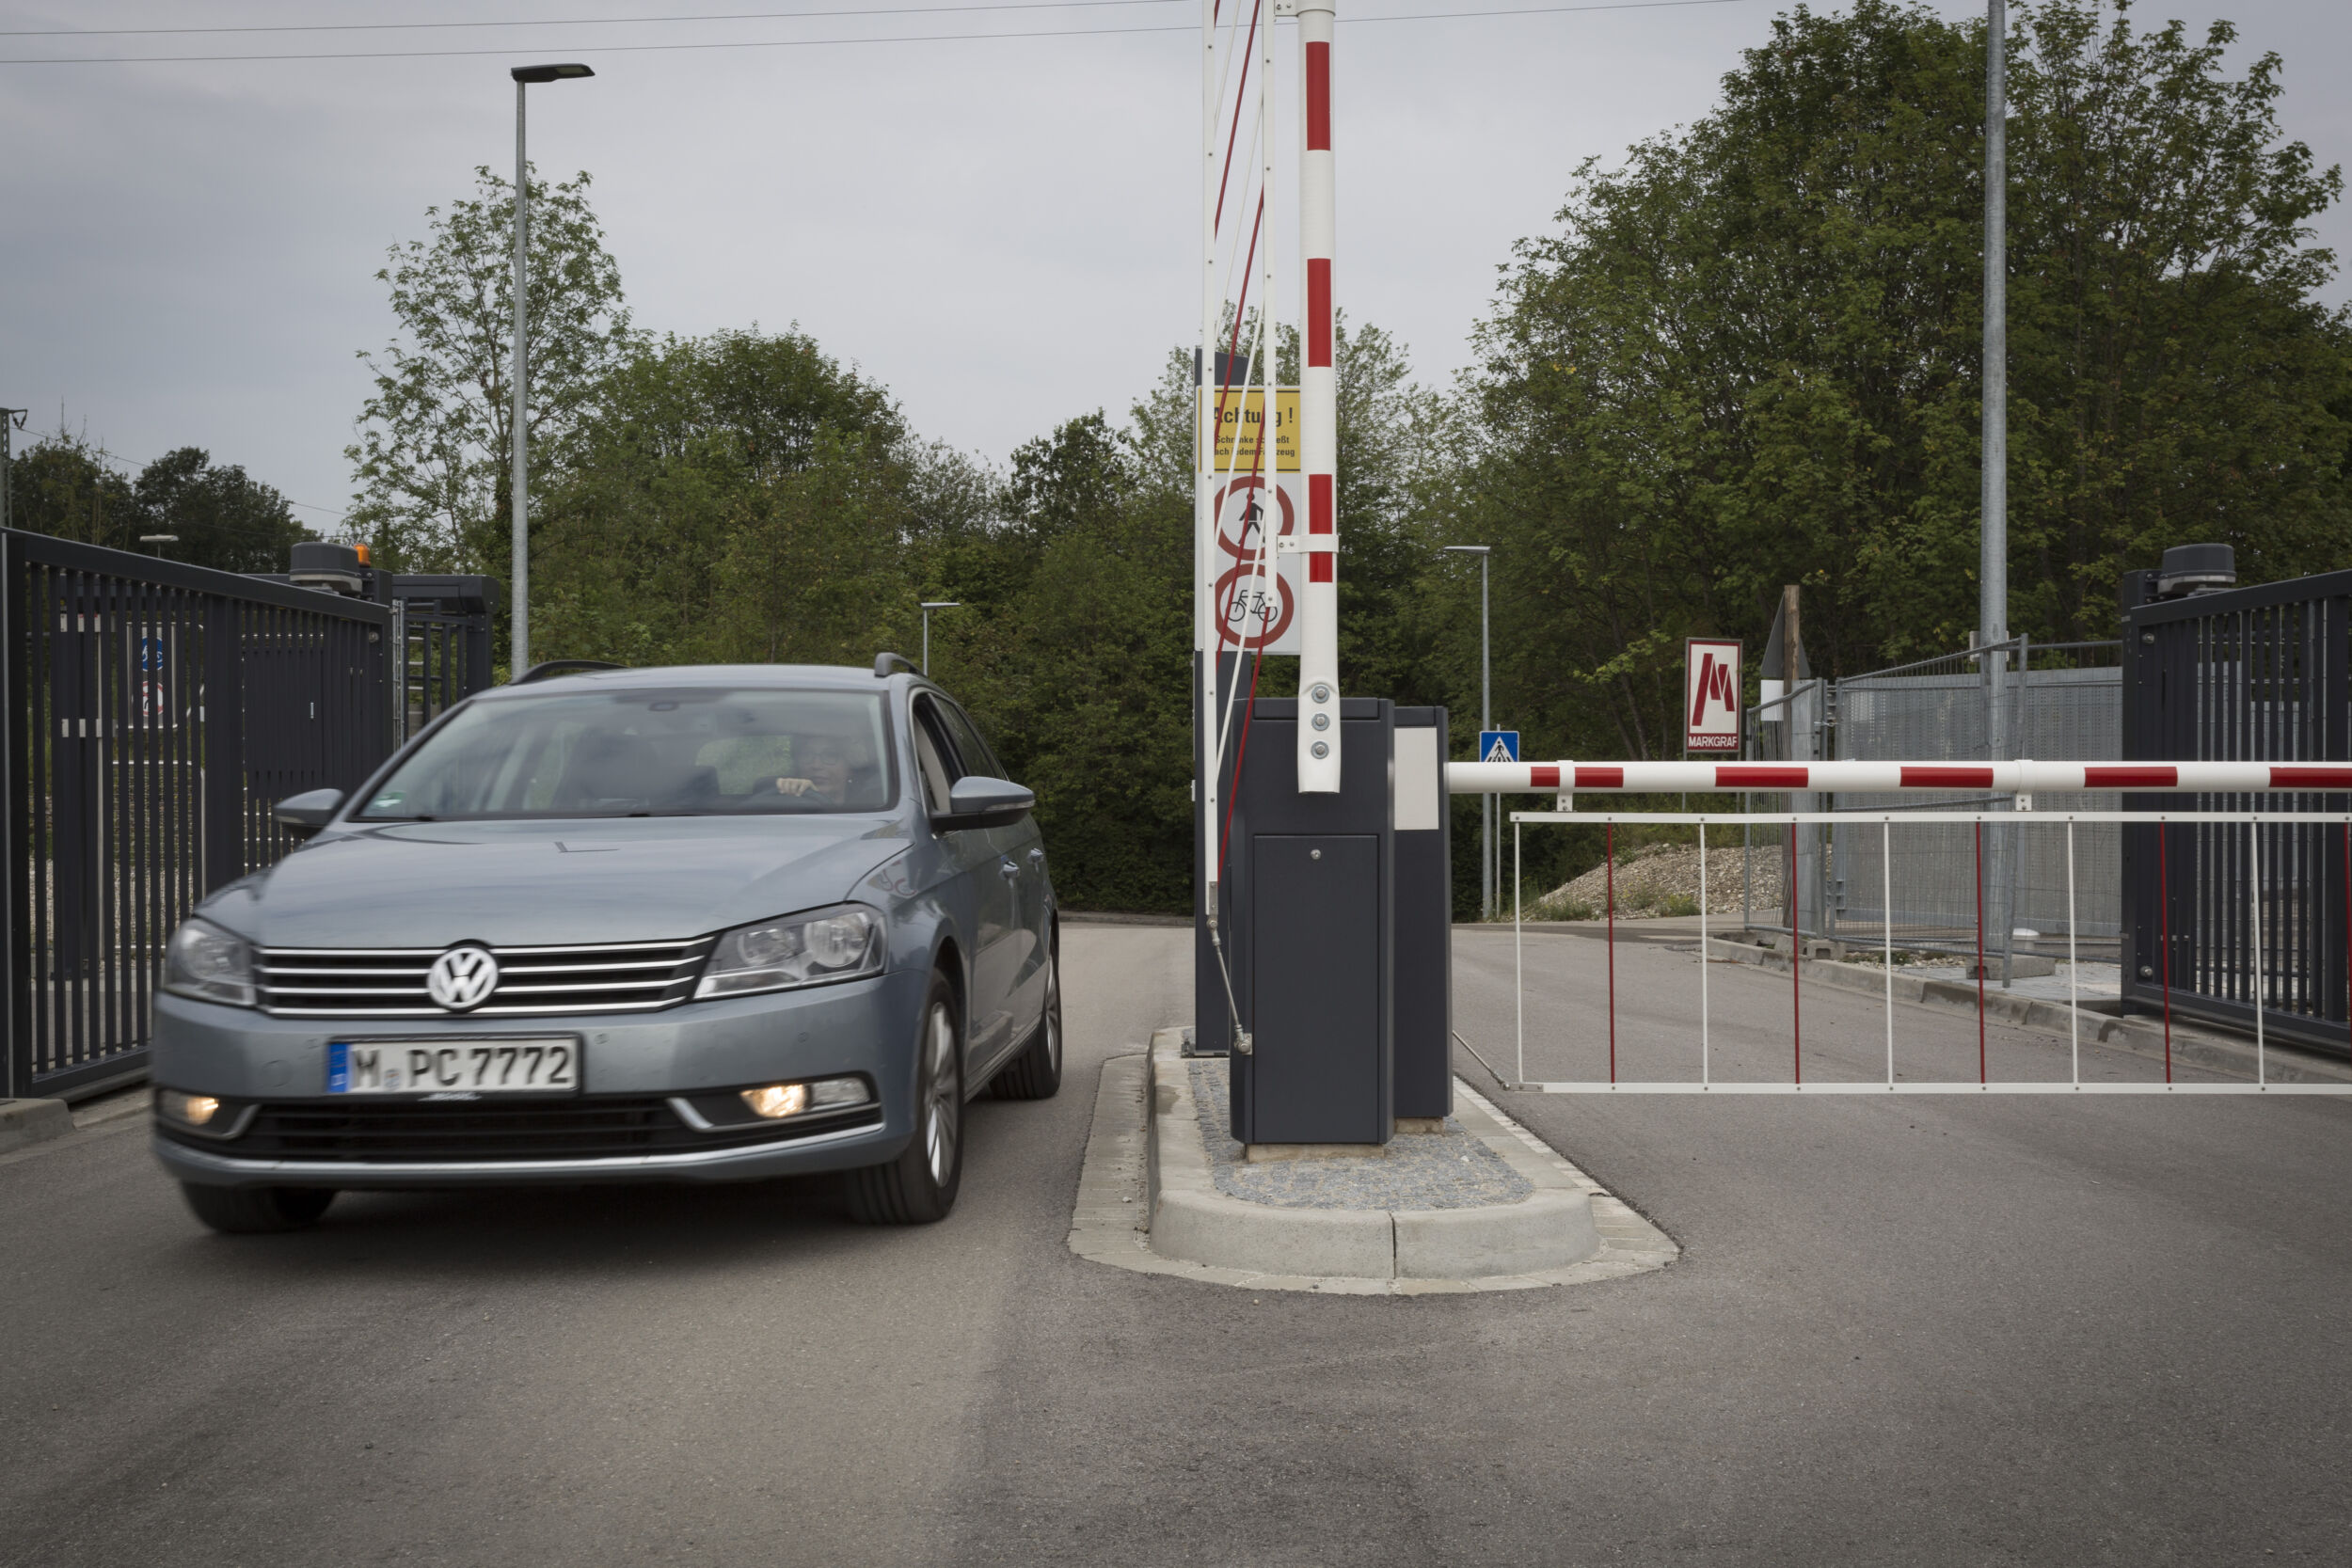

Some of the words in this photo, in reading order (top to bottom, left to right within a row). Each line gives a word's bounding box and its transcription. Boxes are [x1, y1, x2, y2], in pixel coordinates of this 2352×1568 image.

[1213, 406, 1282, 427] Achtug
[1288, 406, 1294, 423] !
[1216, 436, 1254, 444] Schrnke
[1213, 447, 1230, 456] ach
[1688, 736, 1738, 748] MARKGRAF
[352, 1049, 380, 1088] M
[407, 1048, 461, 1086] PC
[469, 1046, 570, 1085] 7772
